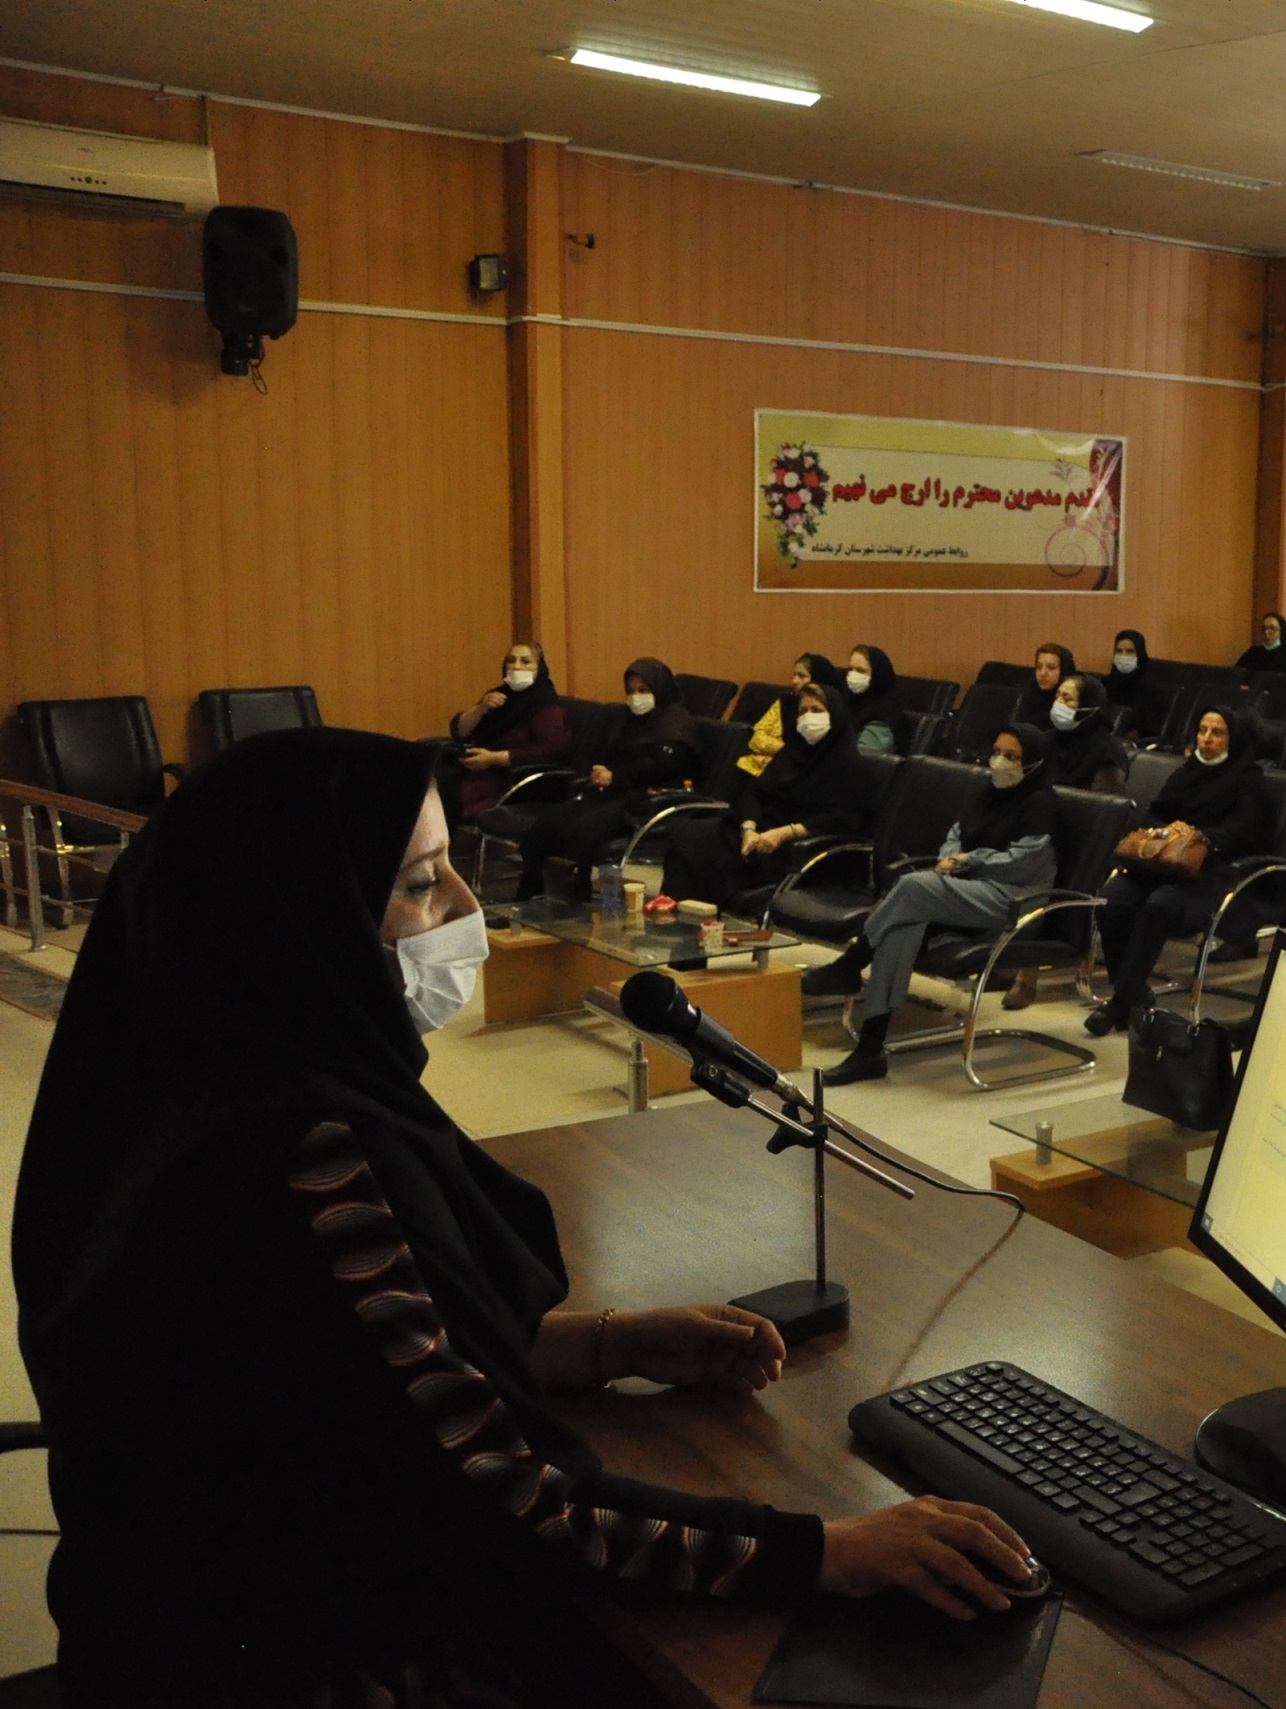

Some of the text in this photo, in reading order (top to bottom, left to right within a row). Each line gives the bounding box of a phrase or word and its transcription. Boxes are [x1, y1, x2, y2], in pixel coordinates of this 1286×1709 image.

[832, 473, 867, 503] نهیم
[869, 483, 897, 505] می
[901, 477, 931, 507] ارج
[934, 478, 950, 508] را
[953, 482, 1001, 508] محترم
[1005, 488, 1062, 511] مدعوین
